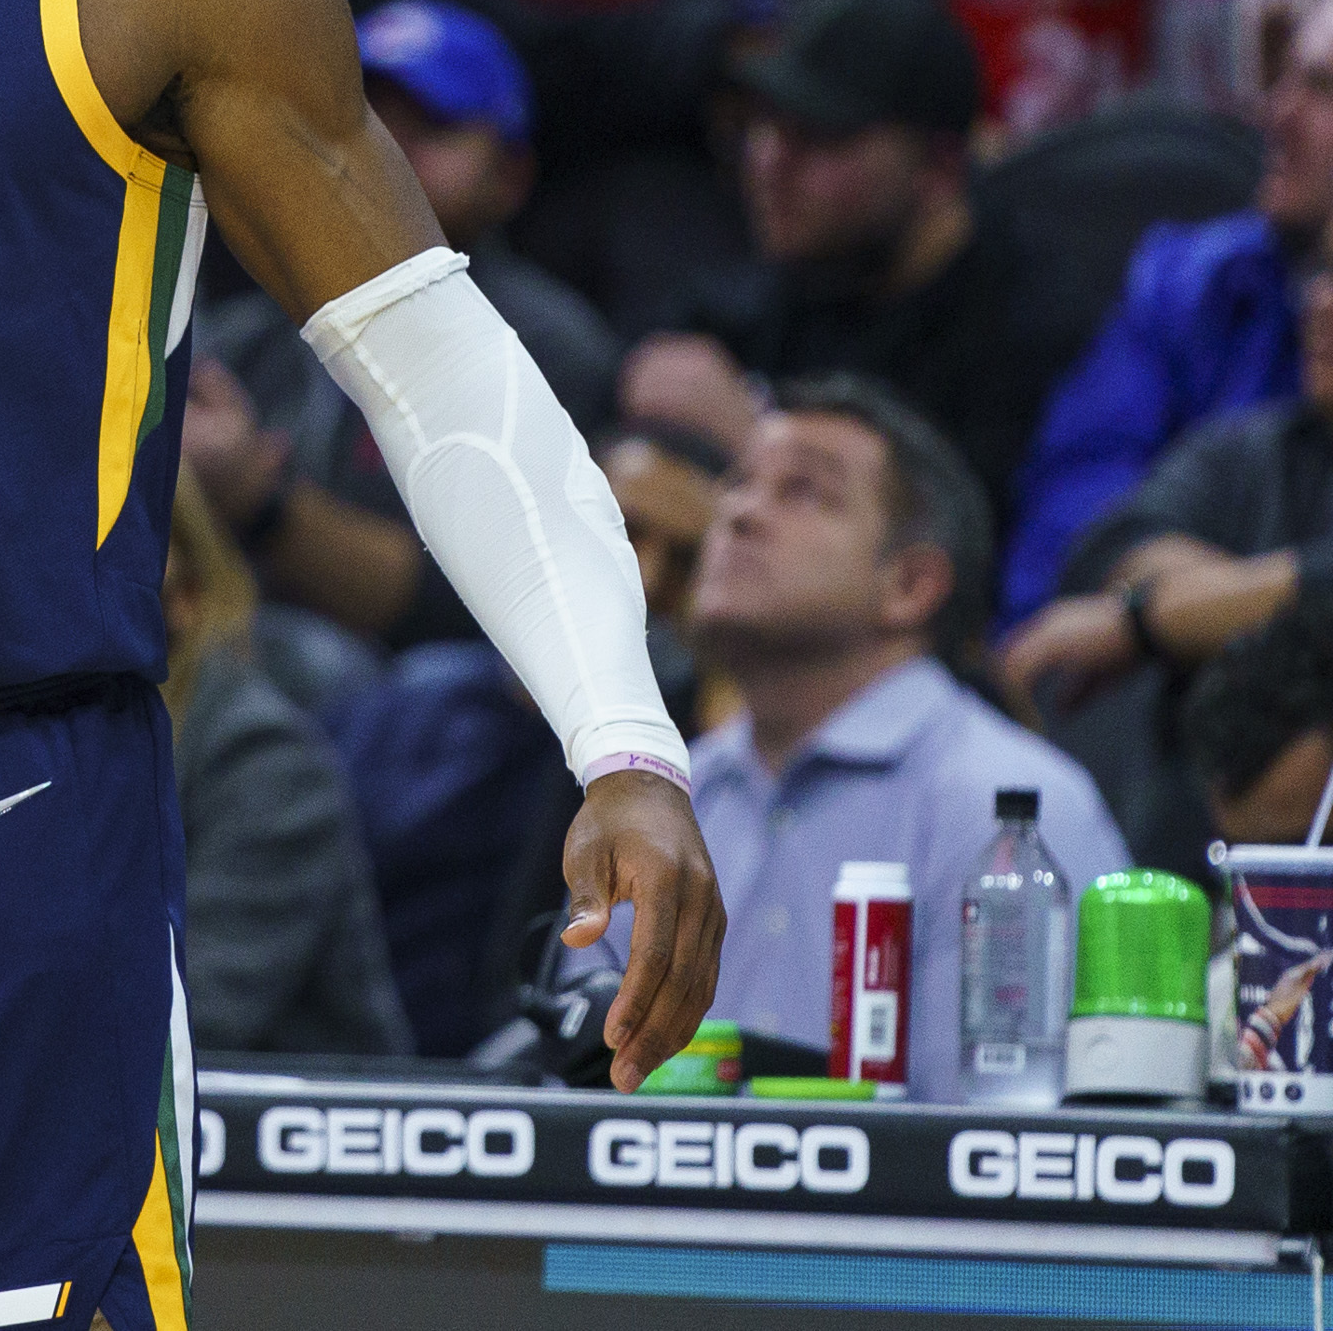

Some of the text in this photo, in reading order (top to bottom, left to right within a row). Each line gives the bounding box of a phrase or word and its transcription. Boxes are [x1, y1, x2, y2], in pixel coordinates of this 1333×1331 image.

[258, 1106, 535, 1177] GEICO
[589, 1117, 871, 1193] GEICO
[947, 1129, 1237, 1208] GEICO
